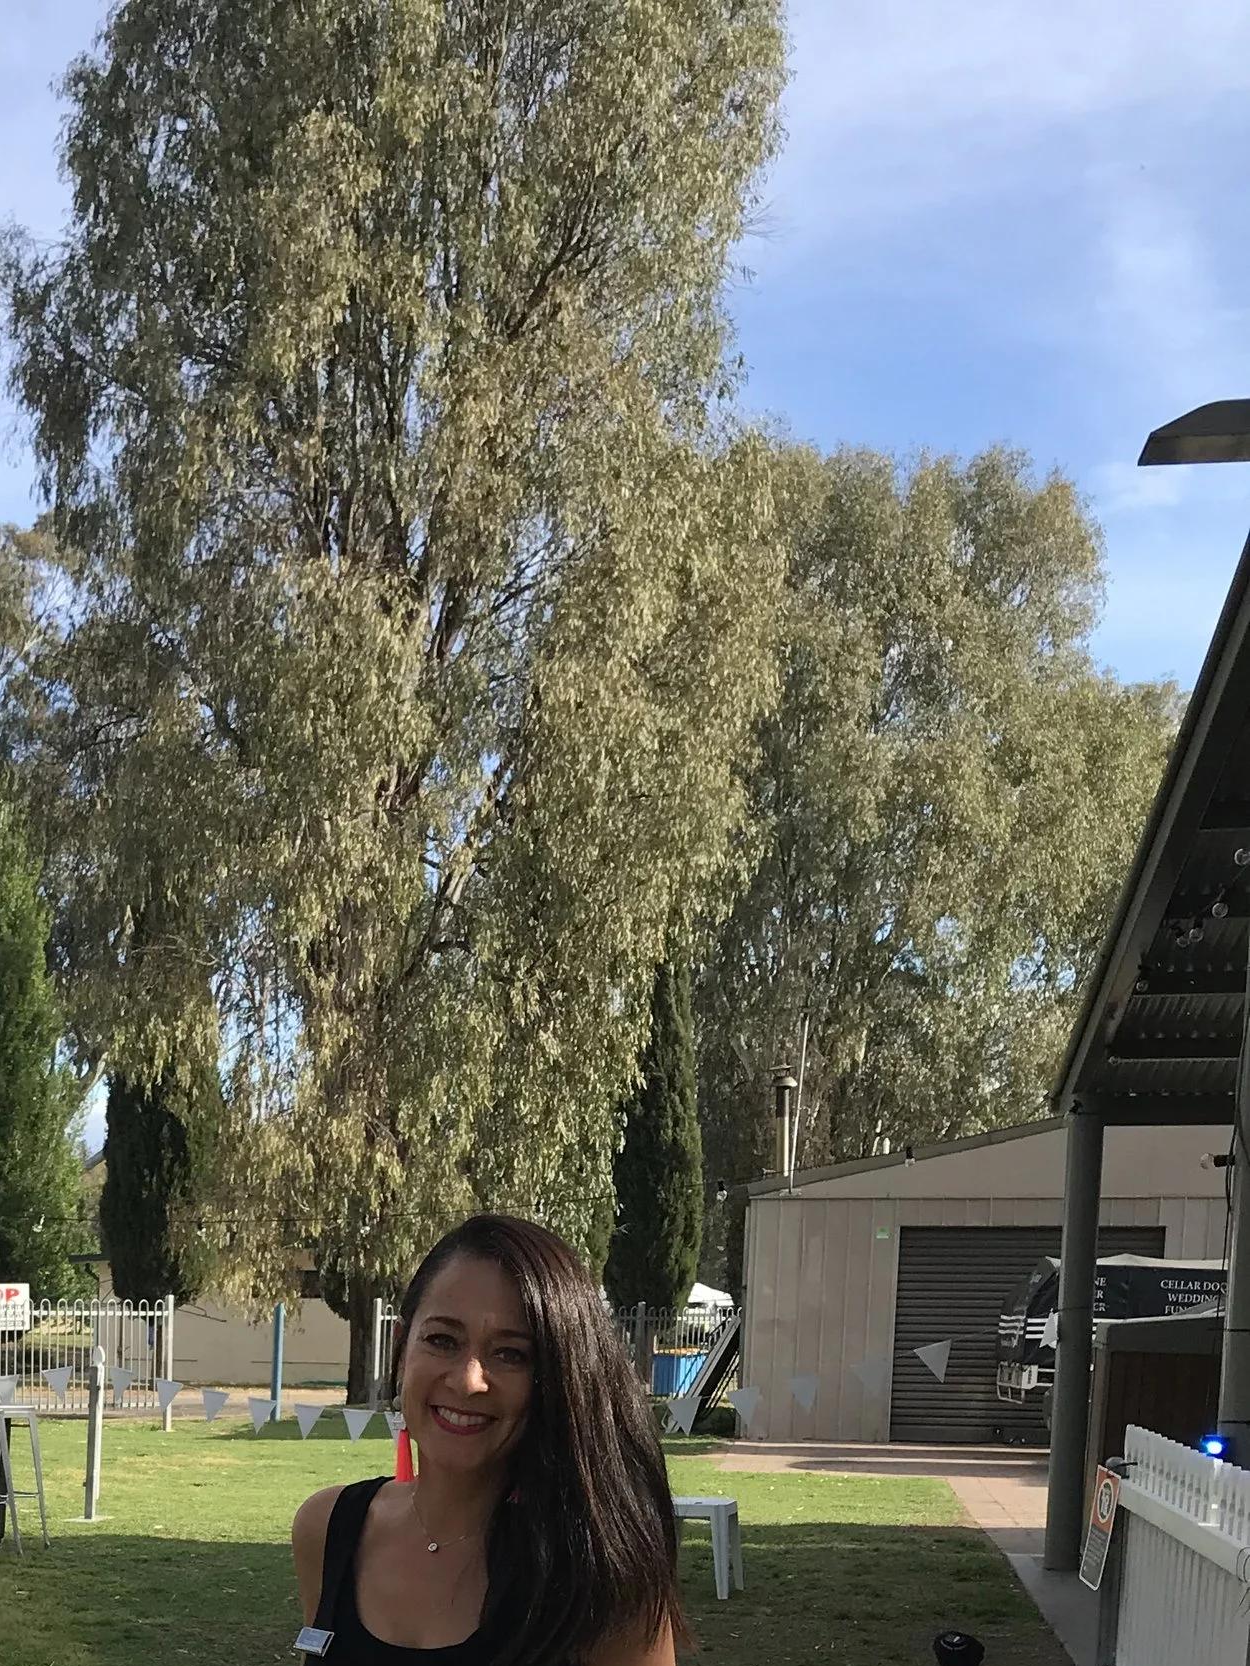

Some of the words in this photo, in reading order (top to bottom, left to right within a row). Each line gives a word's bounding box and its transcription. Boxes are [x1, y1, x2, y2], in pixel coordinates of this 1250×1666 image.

[1094, 1277, 1107, 1287] NE
[1160, 1280, 1201, 1290] CELLAR
[1164, 1305, 1188, 1315] FUN
